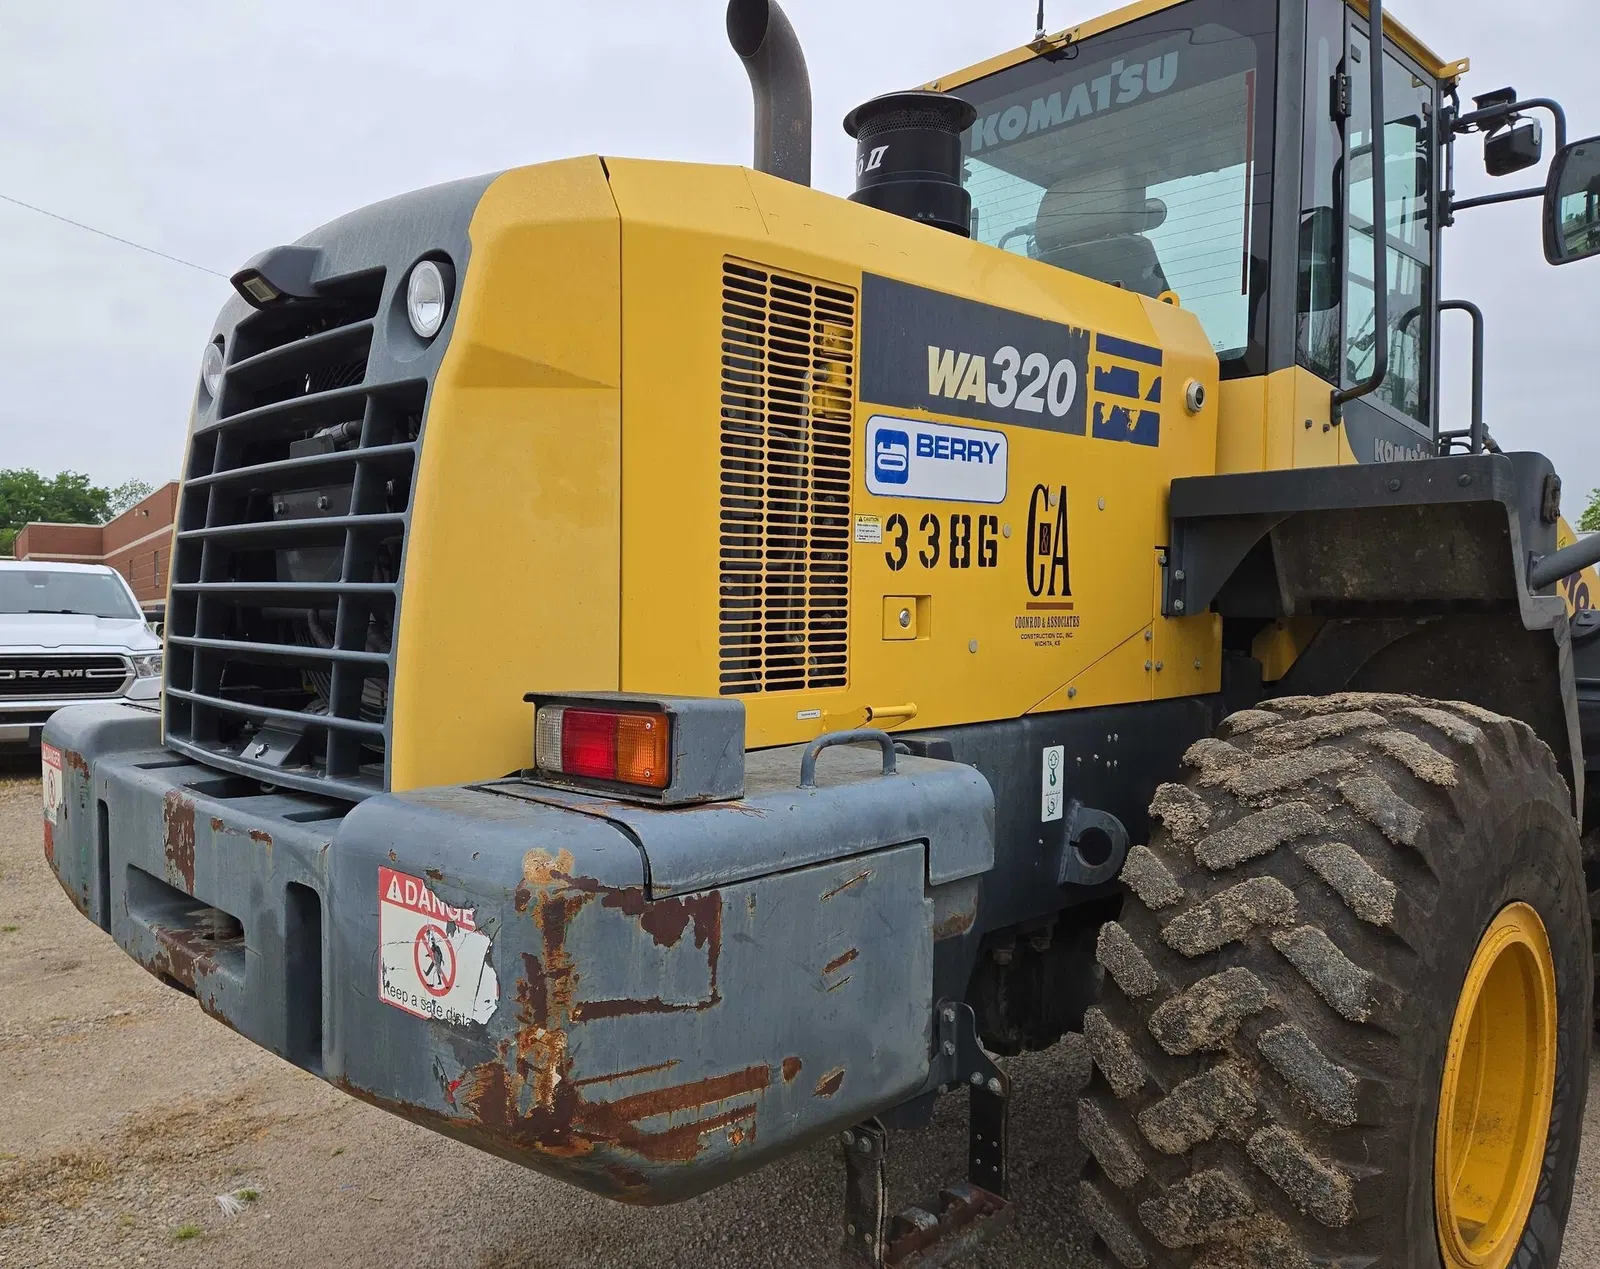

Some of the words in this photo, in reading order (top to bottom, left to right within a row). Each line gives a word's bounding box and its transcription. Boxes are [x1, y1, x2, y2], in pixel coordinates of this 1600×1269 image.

[971, 51, 1179, 151] KOMATSU
[928, 345, 1077, 417] WA320
[916, 433, 1000, 464] BERRY
[1374, 437, 1434, 462] KOMAT
[1015, 616, 1041, 628] COONROD
[1047, 616, 1080, 628] ASSOCIATES
[19, 669, 83, 678] RAM
[411, 995, 417, 1007] a
